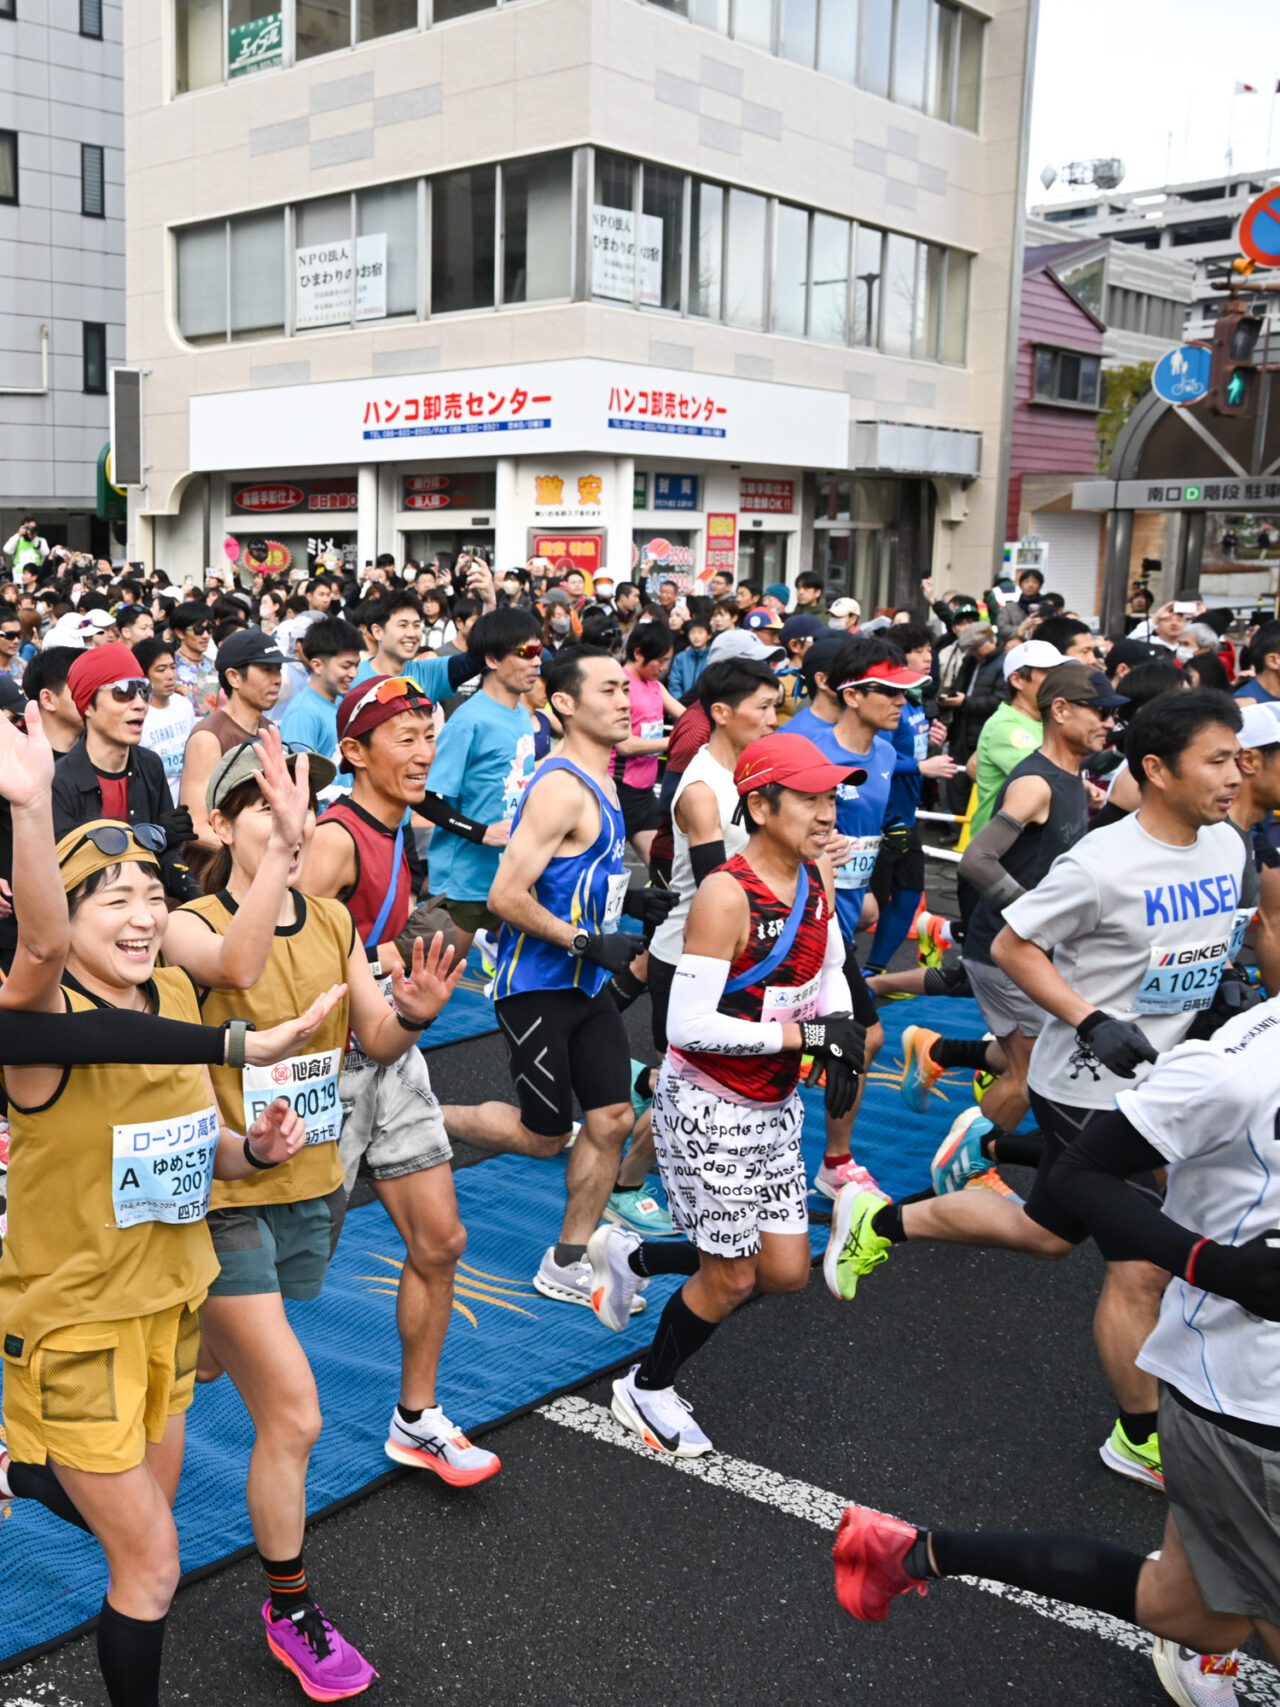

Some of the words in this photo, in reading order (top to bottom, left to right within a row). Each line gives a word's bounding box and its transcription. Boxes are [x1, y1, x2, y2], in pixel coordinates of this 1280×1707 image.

[298, 248, 349, 267] NPO法人
[364, 388, 552, 424] ハンコ卸売センター
[609, 387, 728, 421] ハンコ卸売センター
[1147, 486, 1181, 502] 南口
[1185, 487, 1199, 501] D
[1204, 484, 1239, 501] 階段
[510, 798, 518, 808] A
[1177, 942, 1229, 966] GIKEN
[1145, 978, 1161, 992] A
[291, 1056, 332, 1082] 旭食品
[119, 1168, 140, 1191] A
